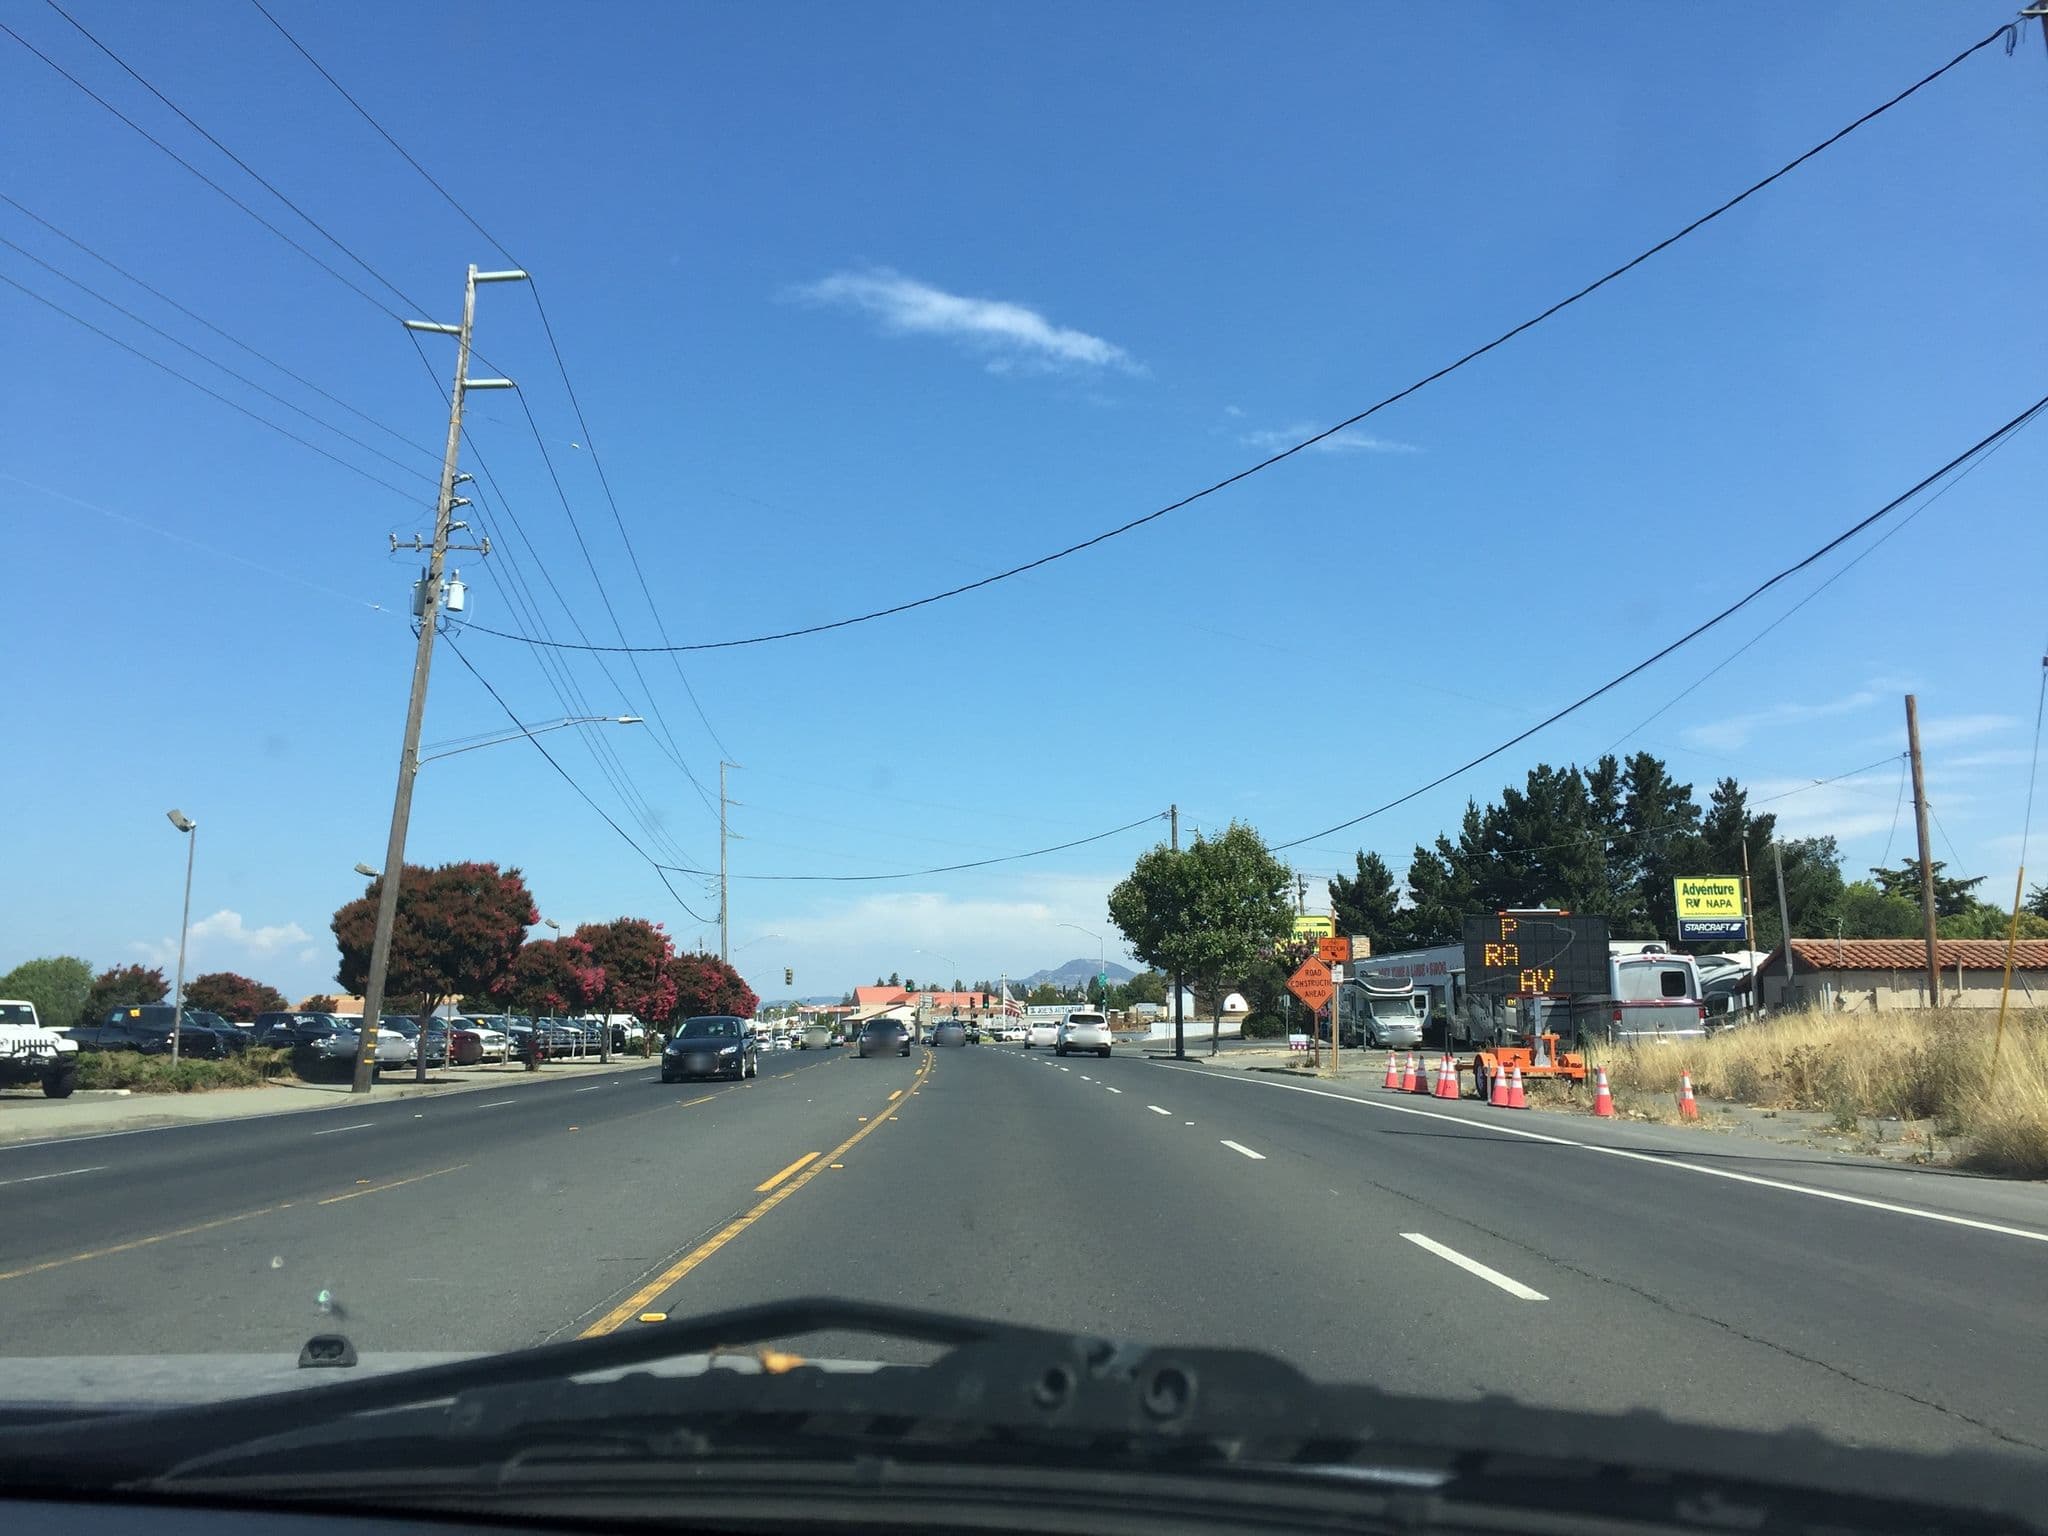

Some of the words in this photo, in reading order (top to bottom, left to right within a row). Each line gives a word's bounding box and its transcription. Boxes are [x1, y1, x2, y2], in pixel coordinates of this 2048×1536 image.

[1682, 883, 1734, 897] Adventure
[1685, 898, 1701, 908] RV
[1706, 899, 1732, 908] NAPA
[1501, 918, 1518, 940] P
[1684, 923, 1731, 931] STARCRAFT
[1485, 943, 1519, 966] RA
[1290, 979, 1332, 988] CONSTRUCTI
[1520, 969, 1554, 992] AY
[1304, 990, 1326, 998] AHEAD
